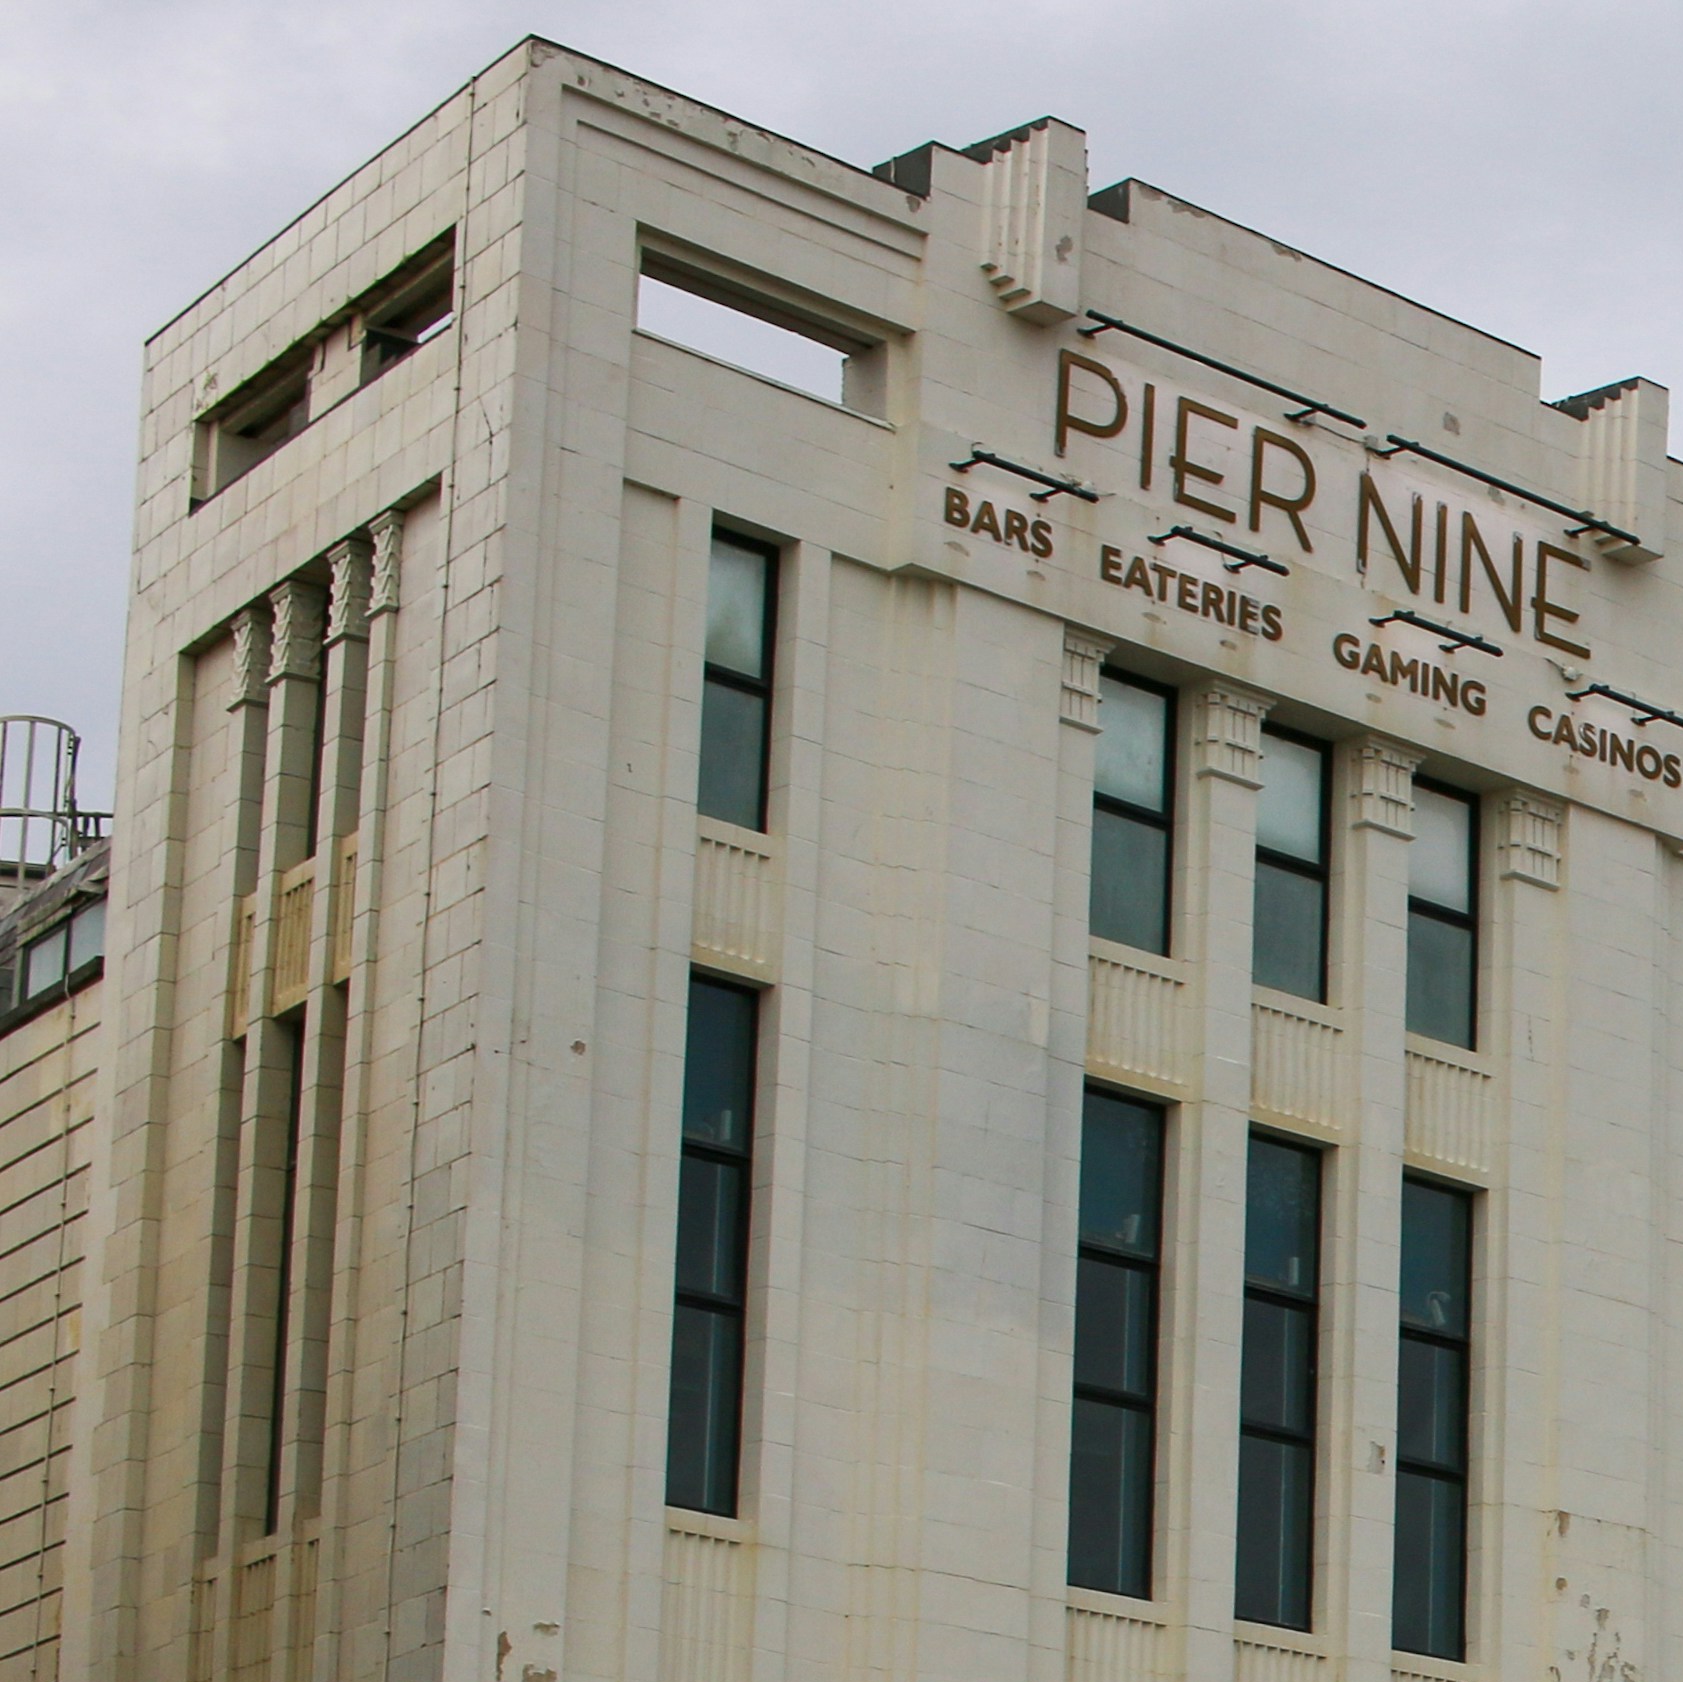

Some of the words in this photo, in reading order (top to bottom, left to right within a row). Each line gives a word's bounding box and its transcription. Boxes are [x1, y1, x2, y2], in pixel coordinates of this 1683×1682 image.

[944, 487, 1054, 559] BARS
[1055, 348, 1316, 552] PIER
[1356, 470, 1592, 659] NINE
[1100, 545, 1283, 641] EATERIES
[1333, 633, 1487, 717] GAMING
[1528, 705, 1682, 788] CASINOS
